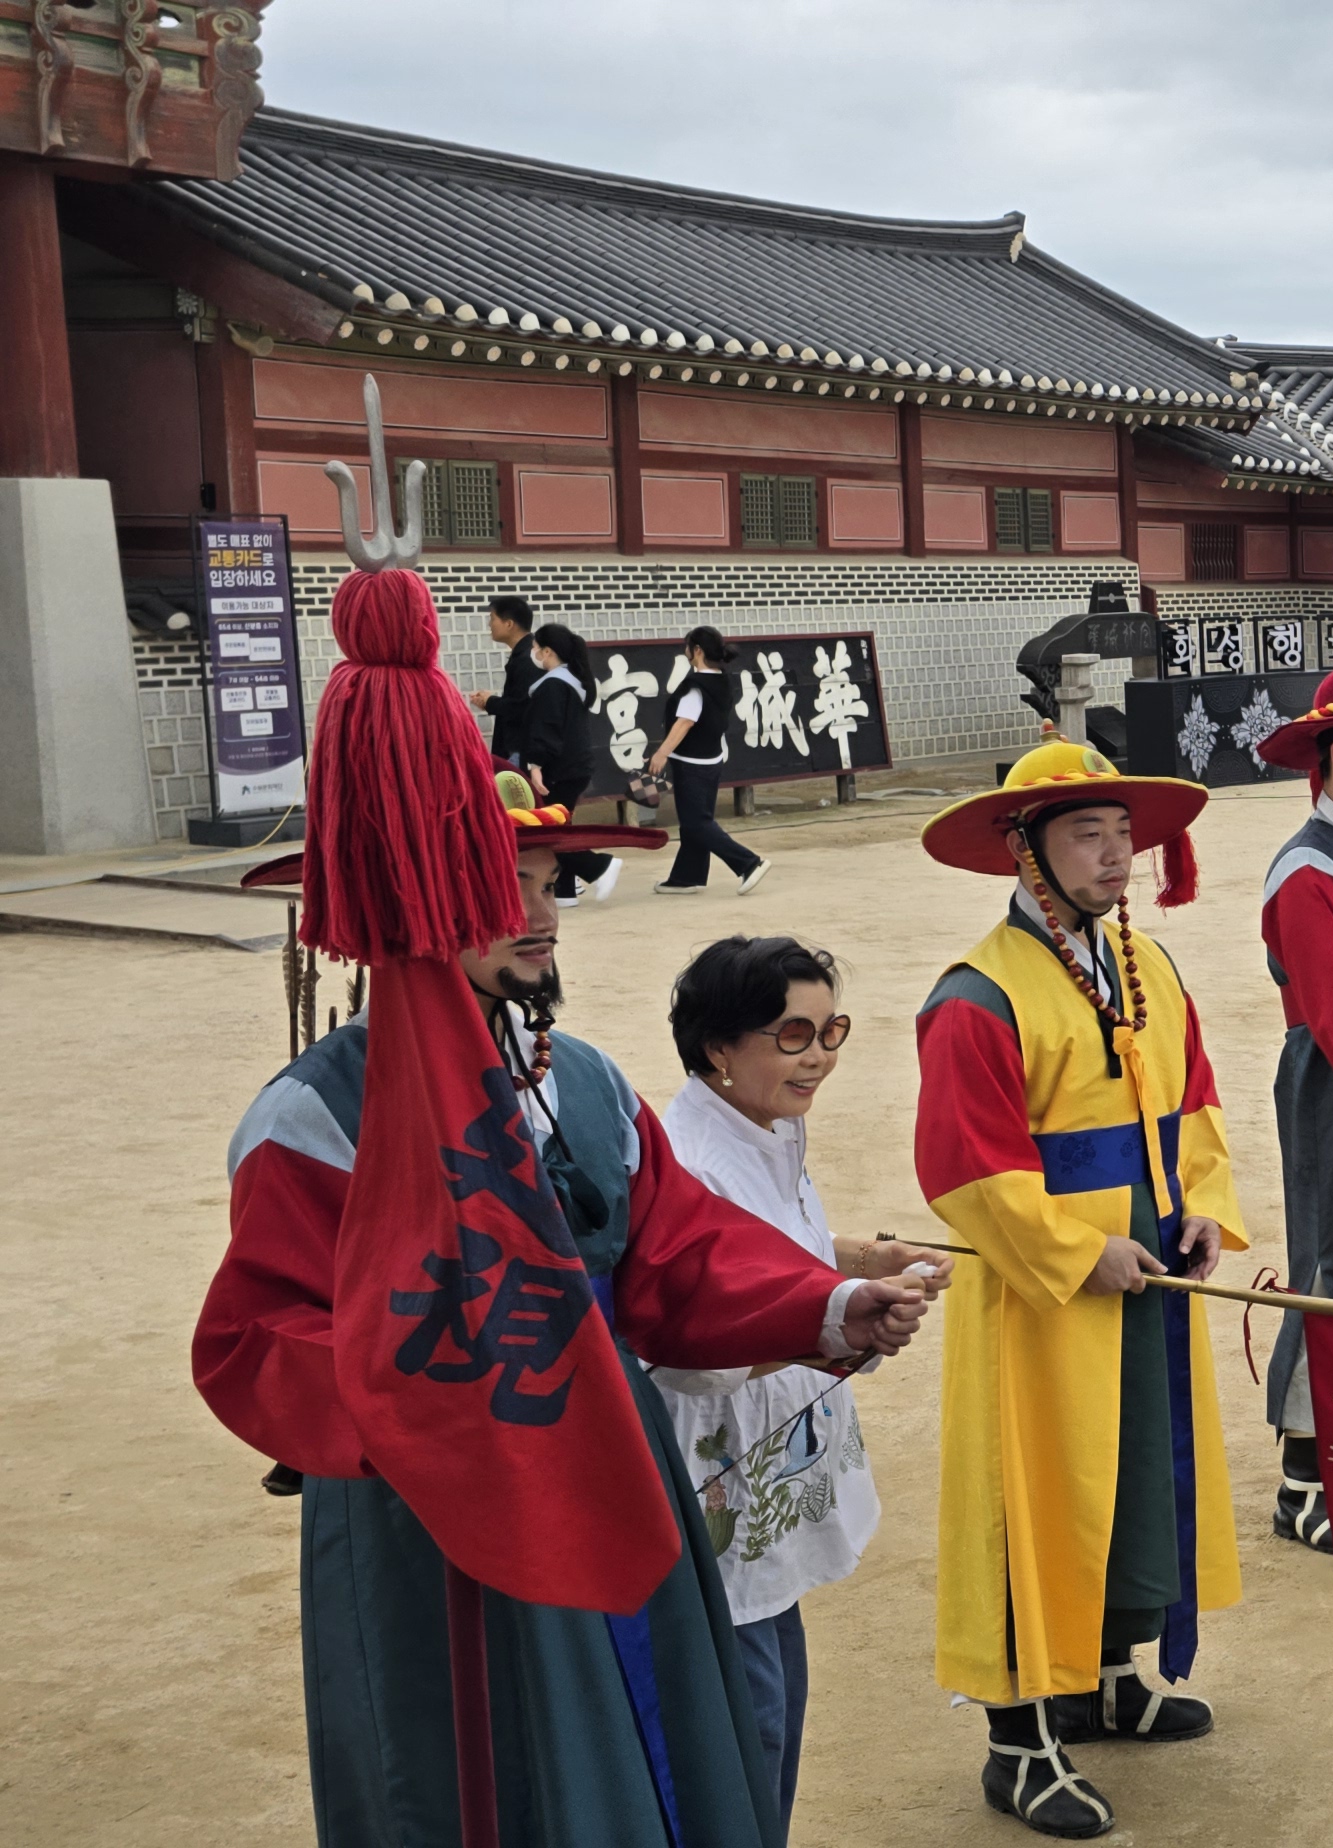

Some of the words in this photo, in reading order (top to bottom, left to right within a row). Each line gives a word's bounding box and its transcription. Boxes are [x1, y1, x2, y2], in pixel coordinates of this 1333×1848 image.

[253, 534, 272, 548] 없이
[208, 550, 274, 567] 교통카드로
[209, 570, 277, 588] 입장하세요
